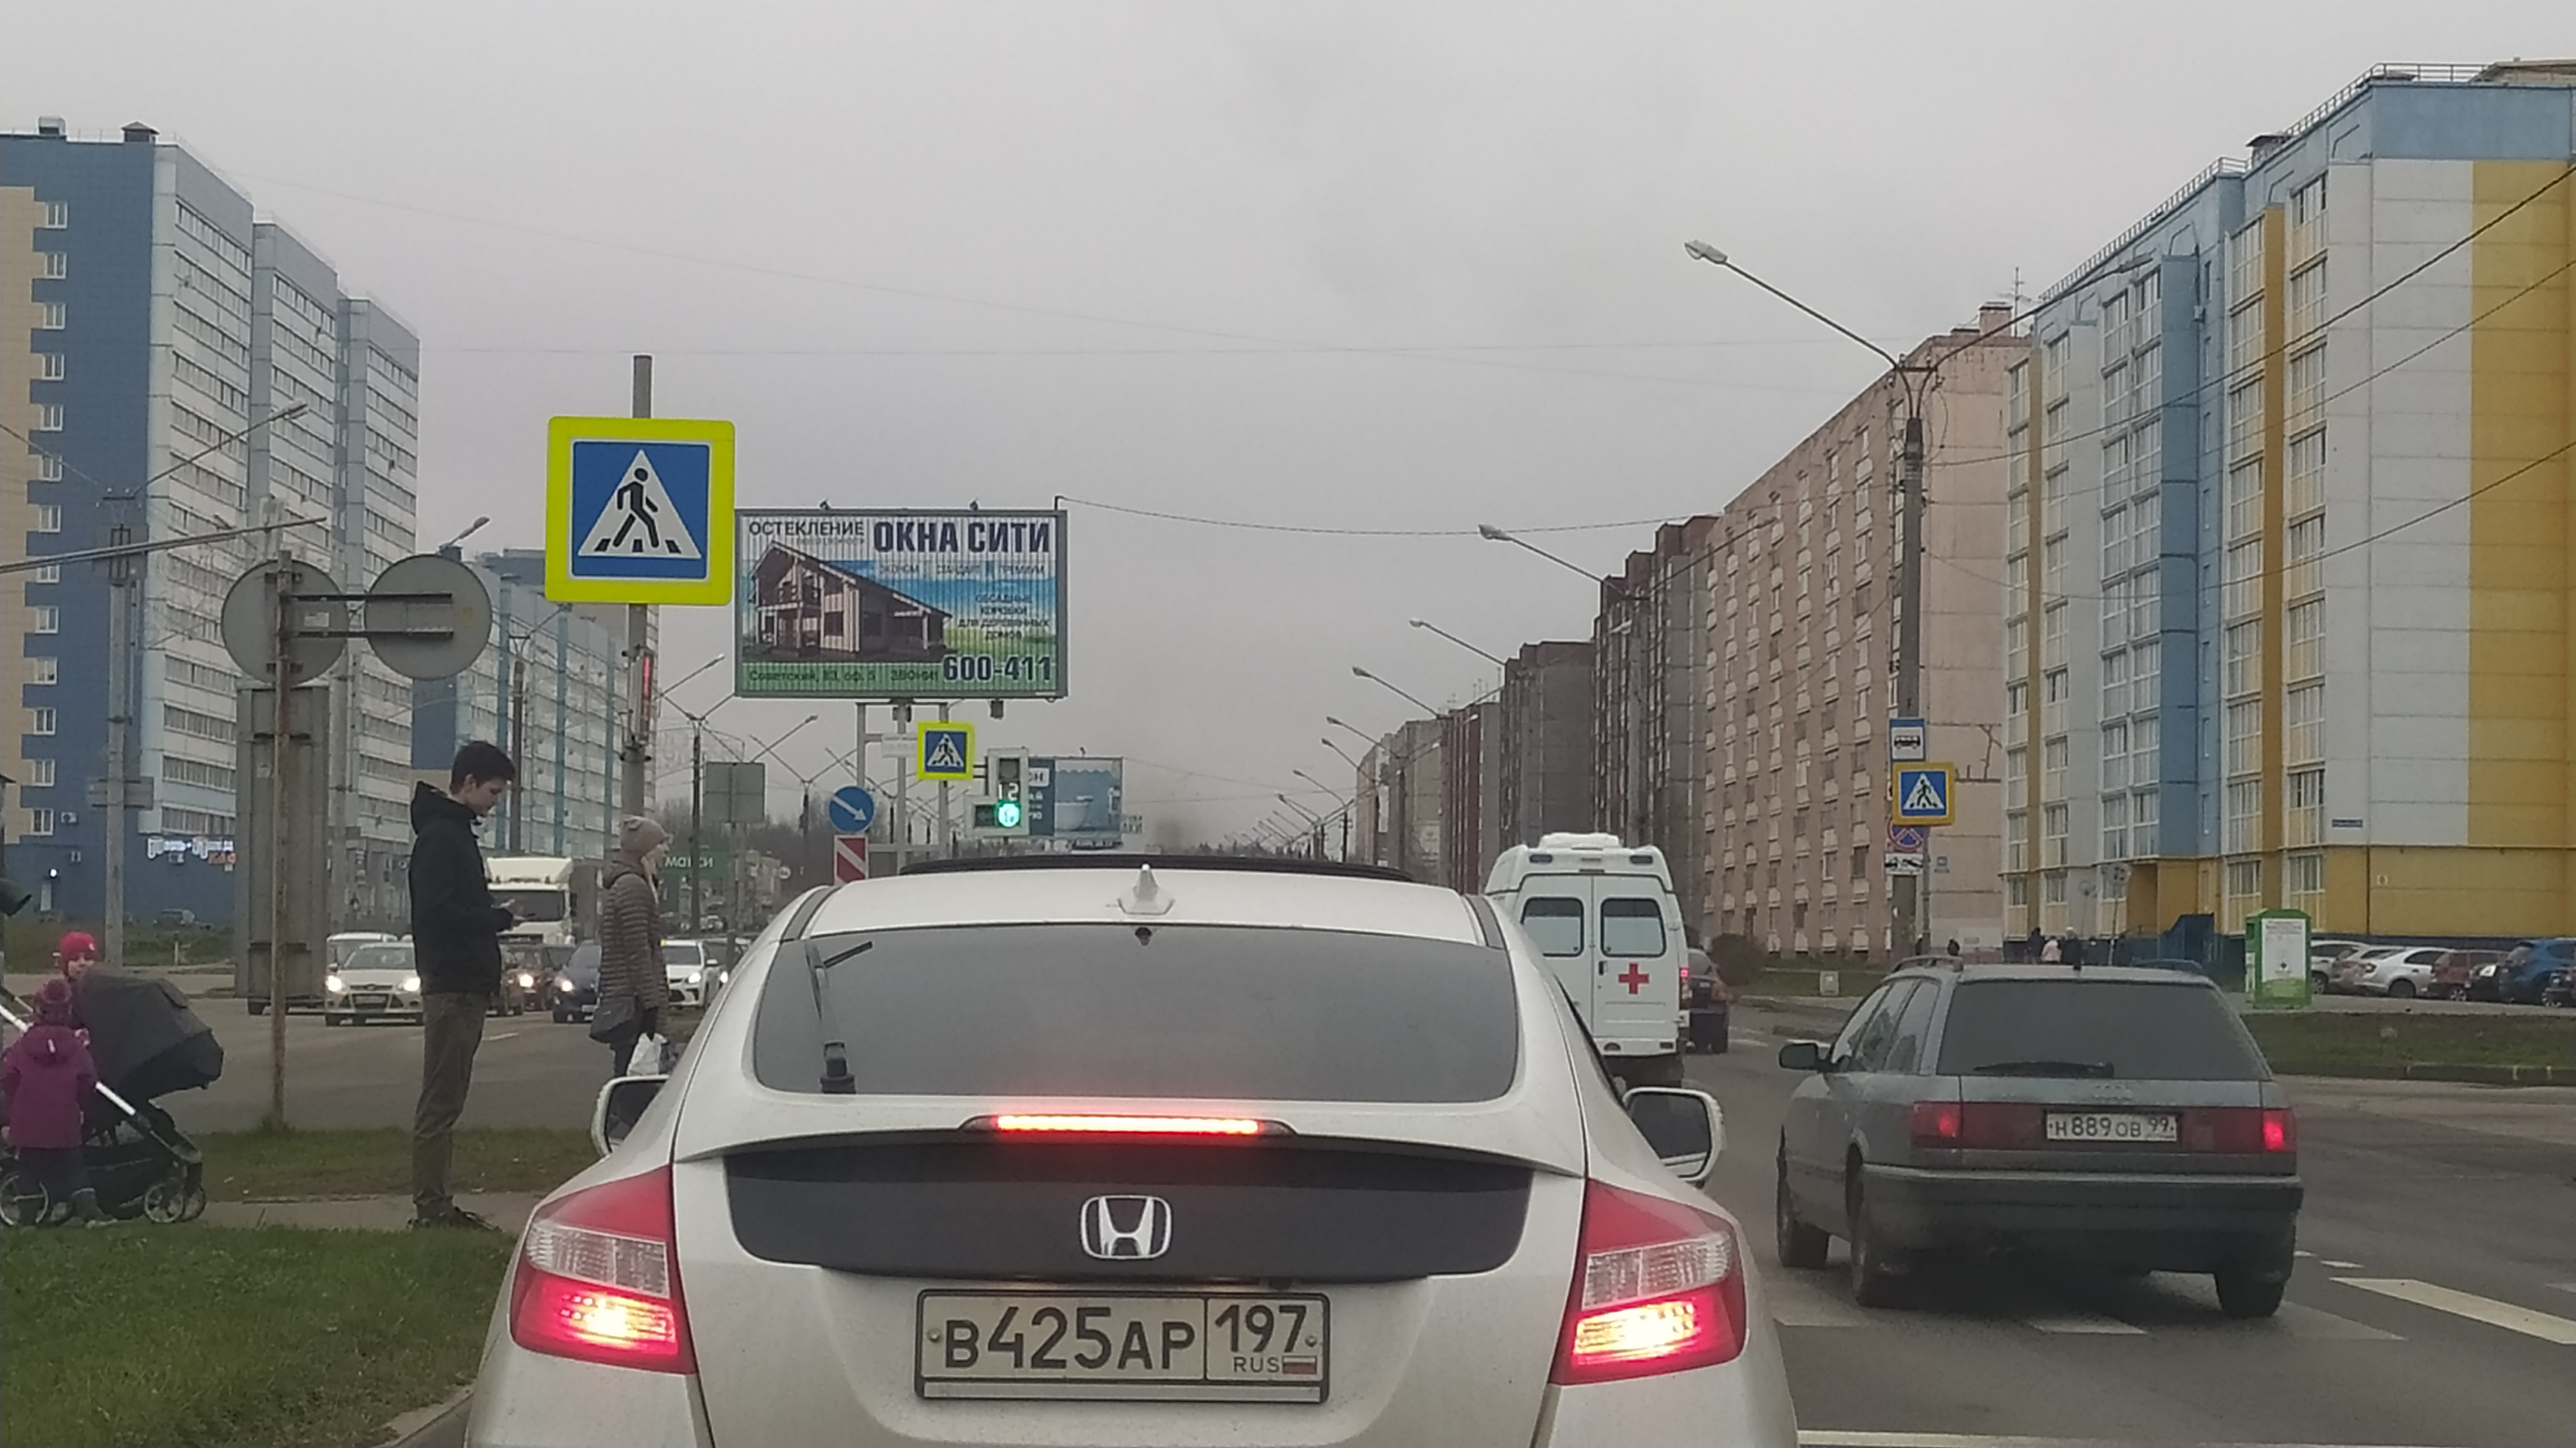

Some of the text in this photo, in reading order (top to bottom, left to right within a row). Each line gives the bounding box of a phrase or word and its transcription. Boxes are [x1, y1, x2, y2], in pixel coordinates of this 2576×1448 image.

[749, 520, 864, 536] ОСТЕКЛЕНИЕ
[874, 521, 1049, 553] ОКНА СИТИ
[943, 654, 1052, 681] 600-411
[998, 782, 1019, 801] 12
[945, 1304, 1308, 1370] В425АР 197
[1233, 1356, 1280, 1374] RUS
